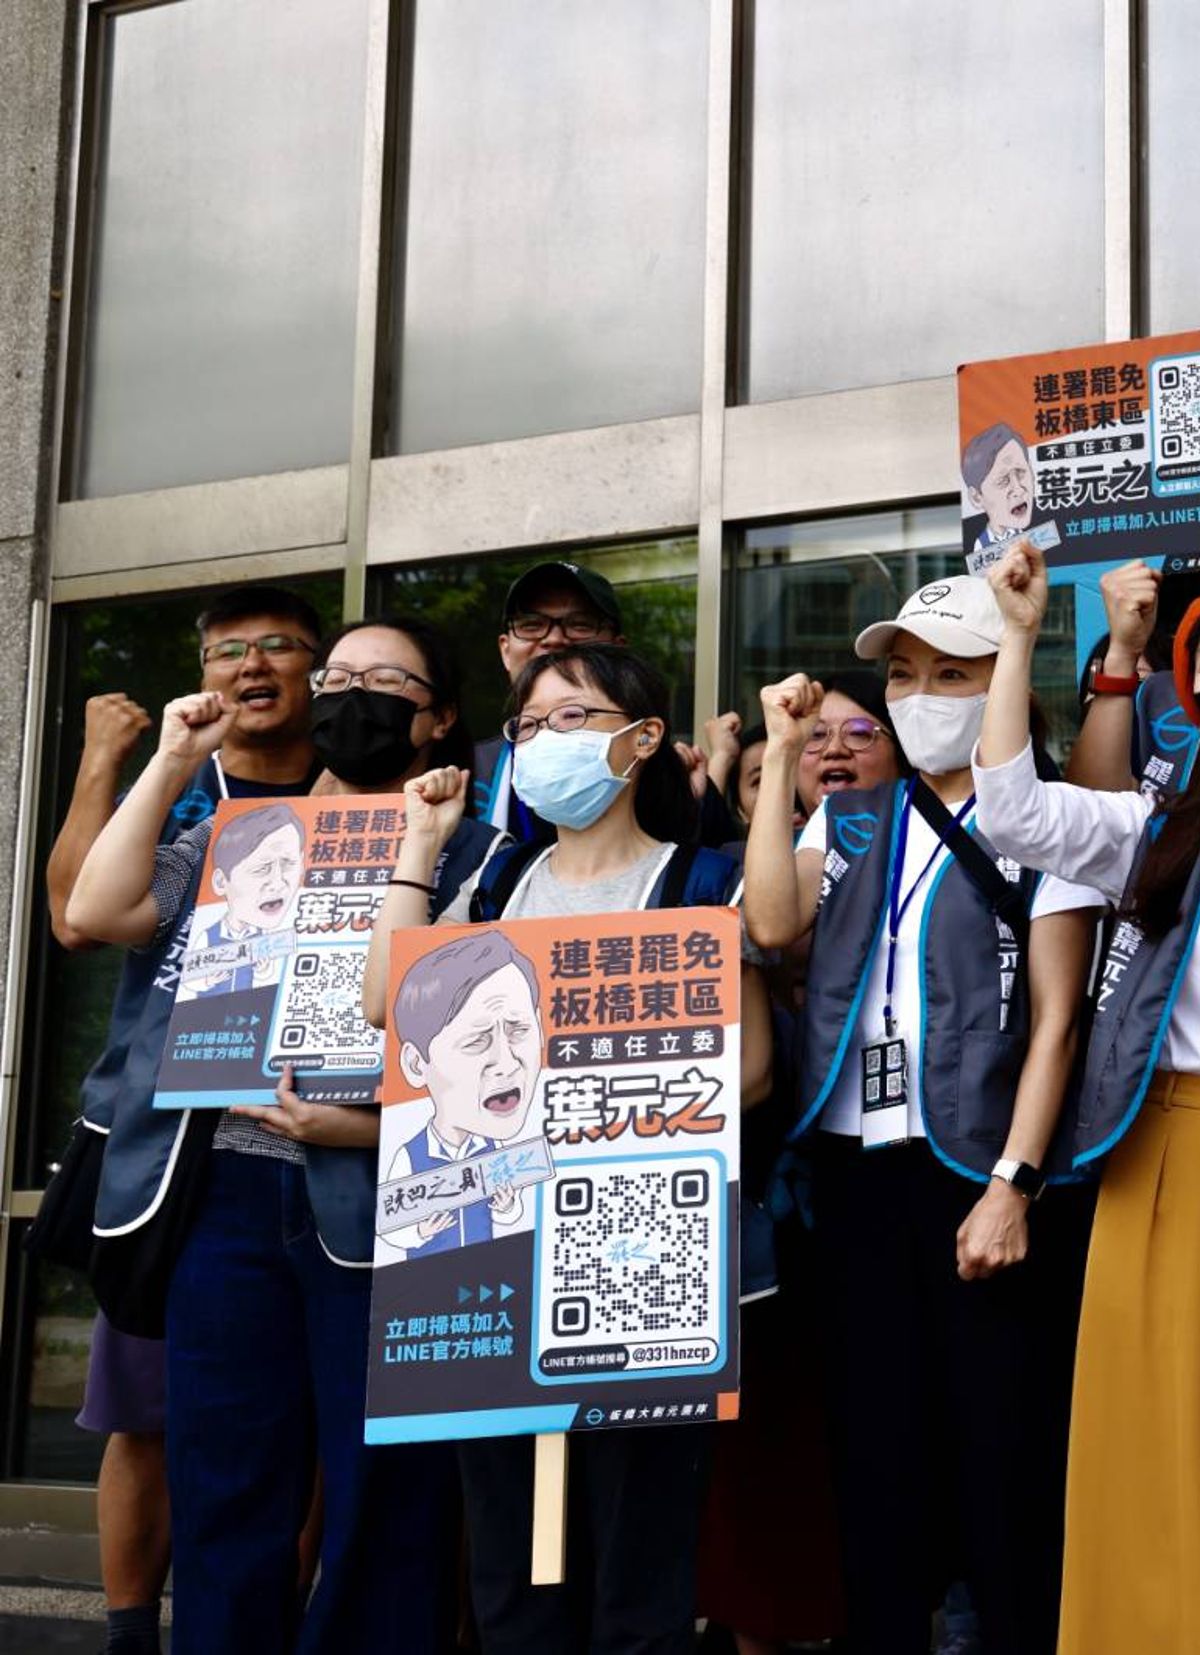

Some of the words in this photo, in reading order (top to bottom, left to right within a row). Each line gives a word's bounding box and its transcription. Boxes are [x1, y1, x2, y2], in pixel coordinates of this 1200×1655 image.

[1033, 362, 1145, 404] 連署罷免
[1035, 396, 1145, 438] 板橋東區
[1046, 436, 1133, 459] 不適任立委
[1035, 459, 1148, 511] 葉元之
[310, 838, 403, 864] 板橋東
[549, 930, 724, 981] 連署罷免
[549, 977, 724, 1029] 板橋東區
[557, 1030, 716, 1062] 不適任立委
[543, 1066, 726, 1146] 葉元之
[384, 1310, 514, 1340] 立即掃碼加入
[384, 1336, 514, 1364] LINE官方帳號
[632, 1345, 711, 1363] @331hnzcp
